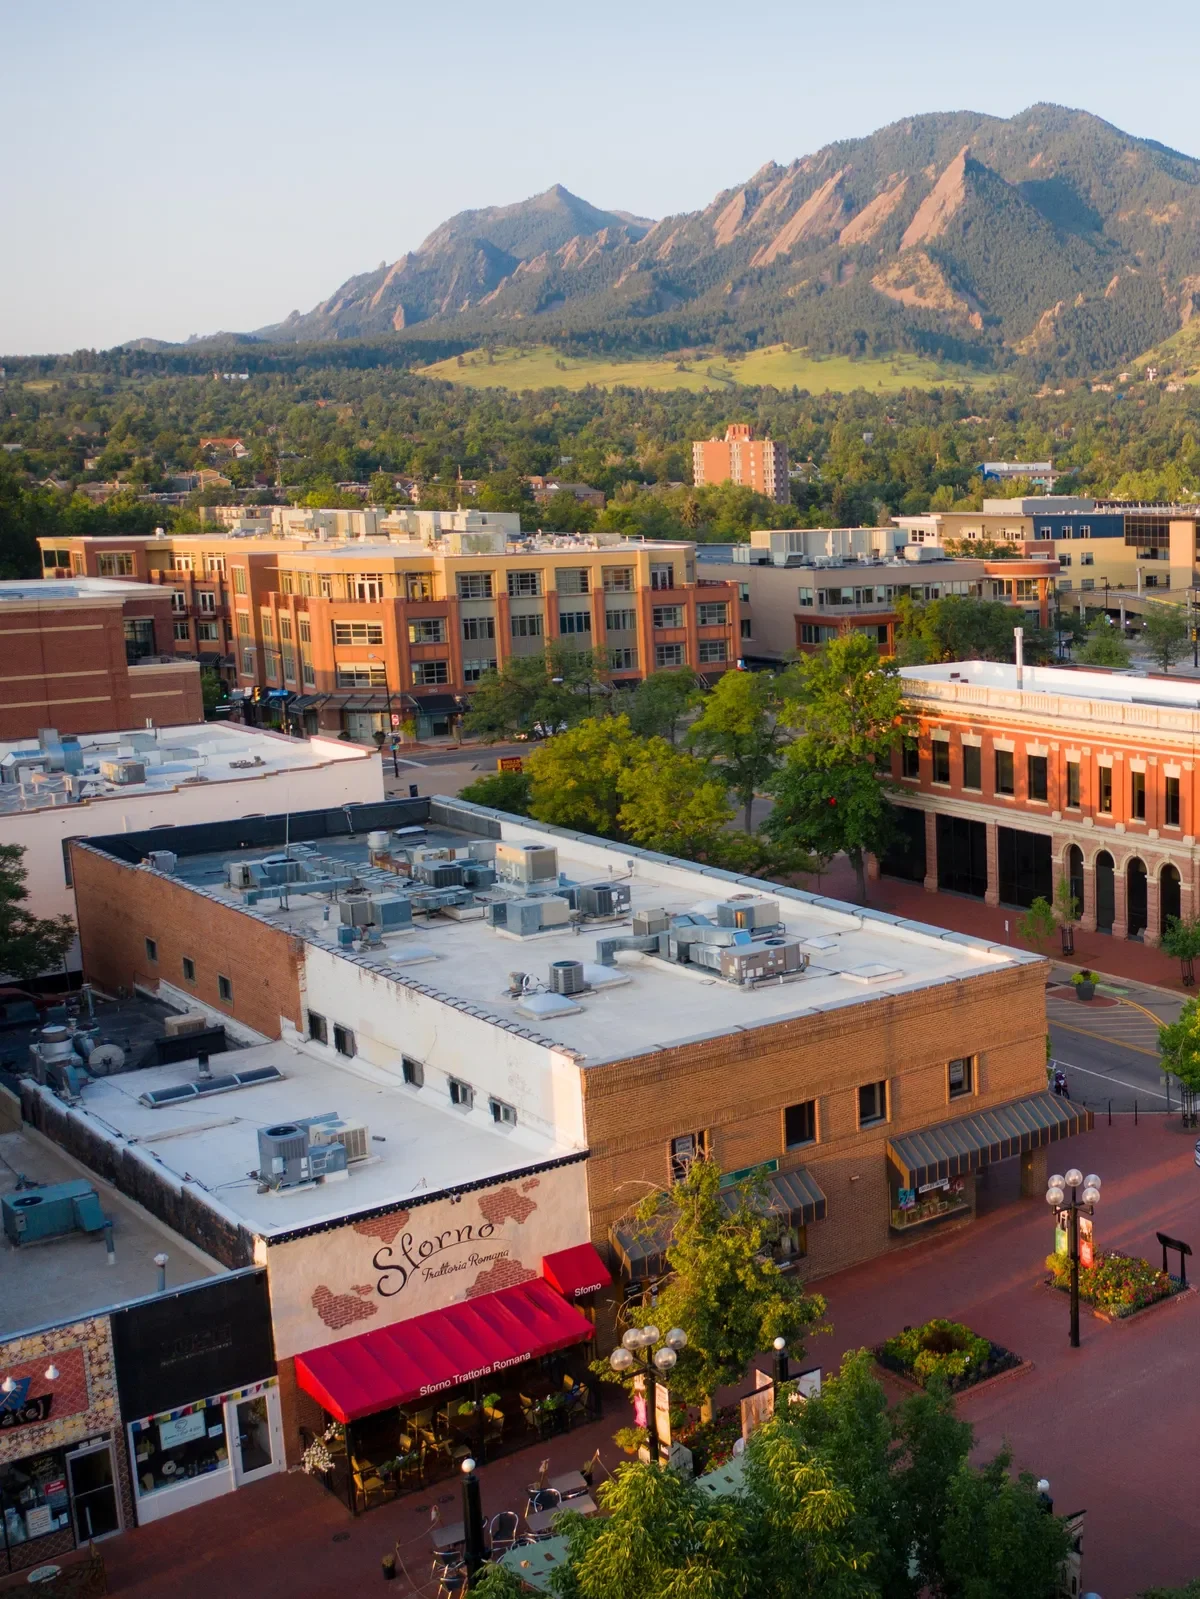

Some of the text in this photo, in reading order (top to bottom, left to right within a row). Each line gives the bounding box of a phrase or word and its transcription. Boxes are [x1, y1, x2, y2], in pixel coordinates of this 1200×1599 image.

[373, 1222, 496, 1297] Sforno
[422, 1250, 510, 1283] Trattoria Romana
[574, 1282, 602, 1297] Sforno
[420, 1352, 531, 1396] Sforno Trattoria Romana
